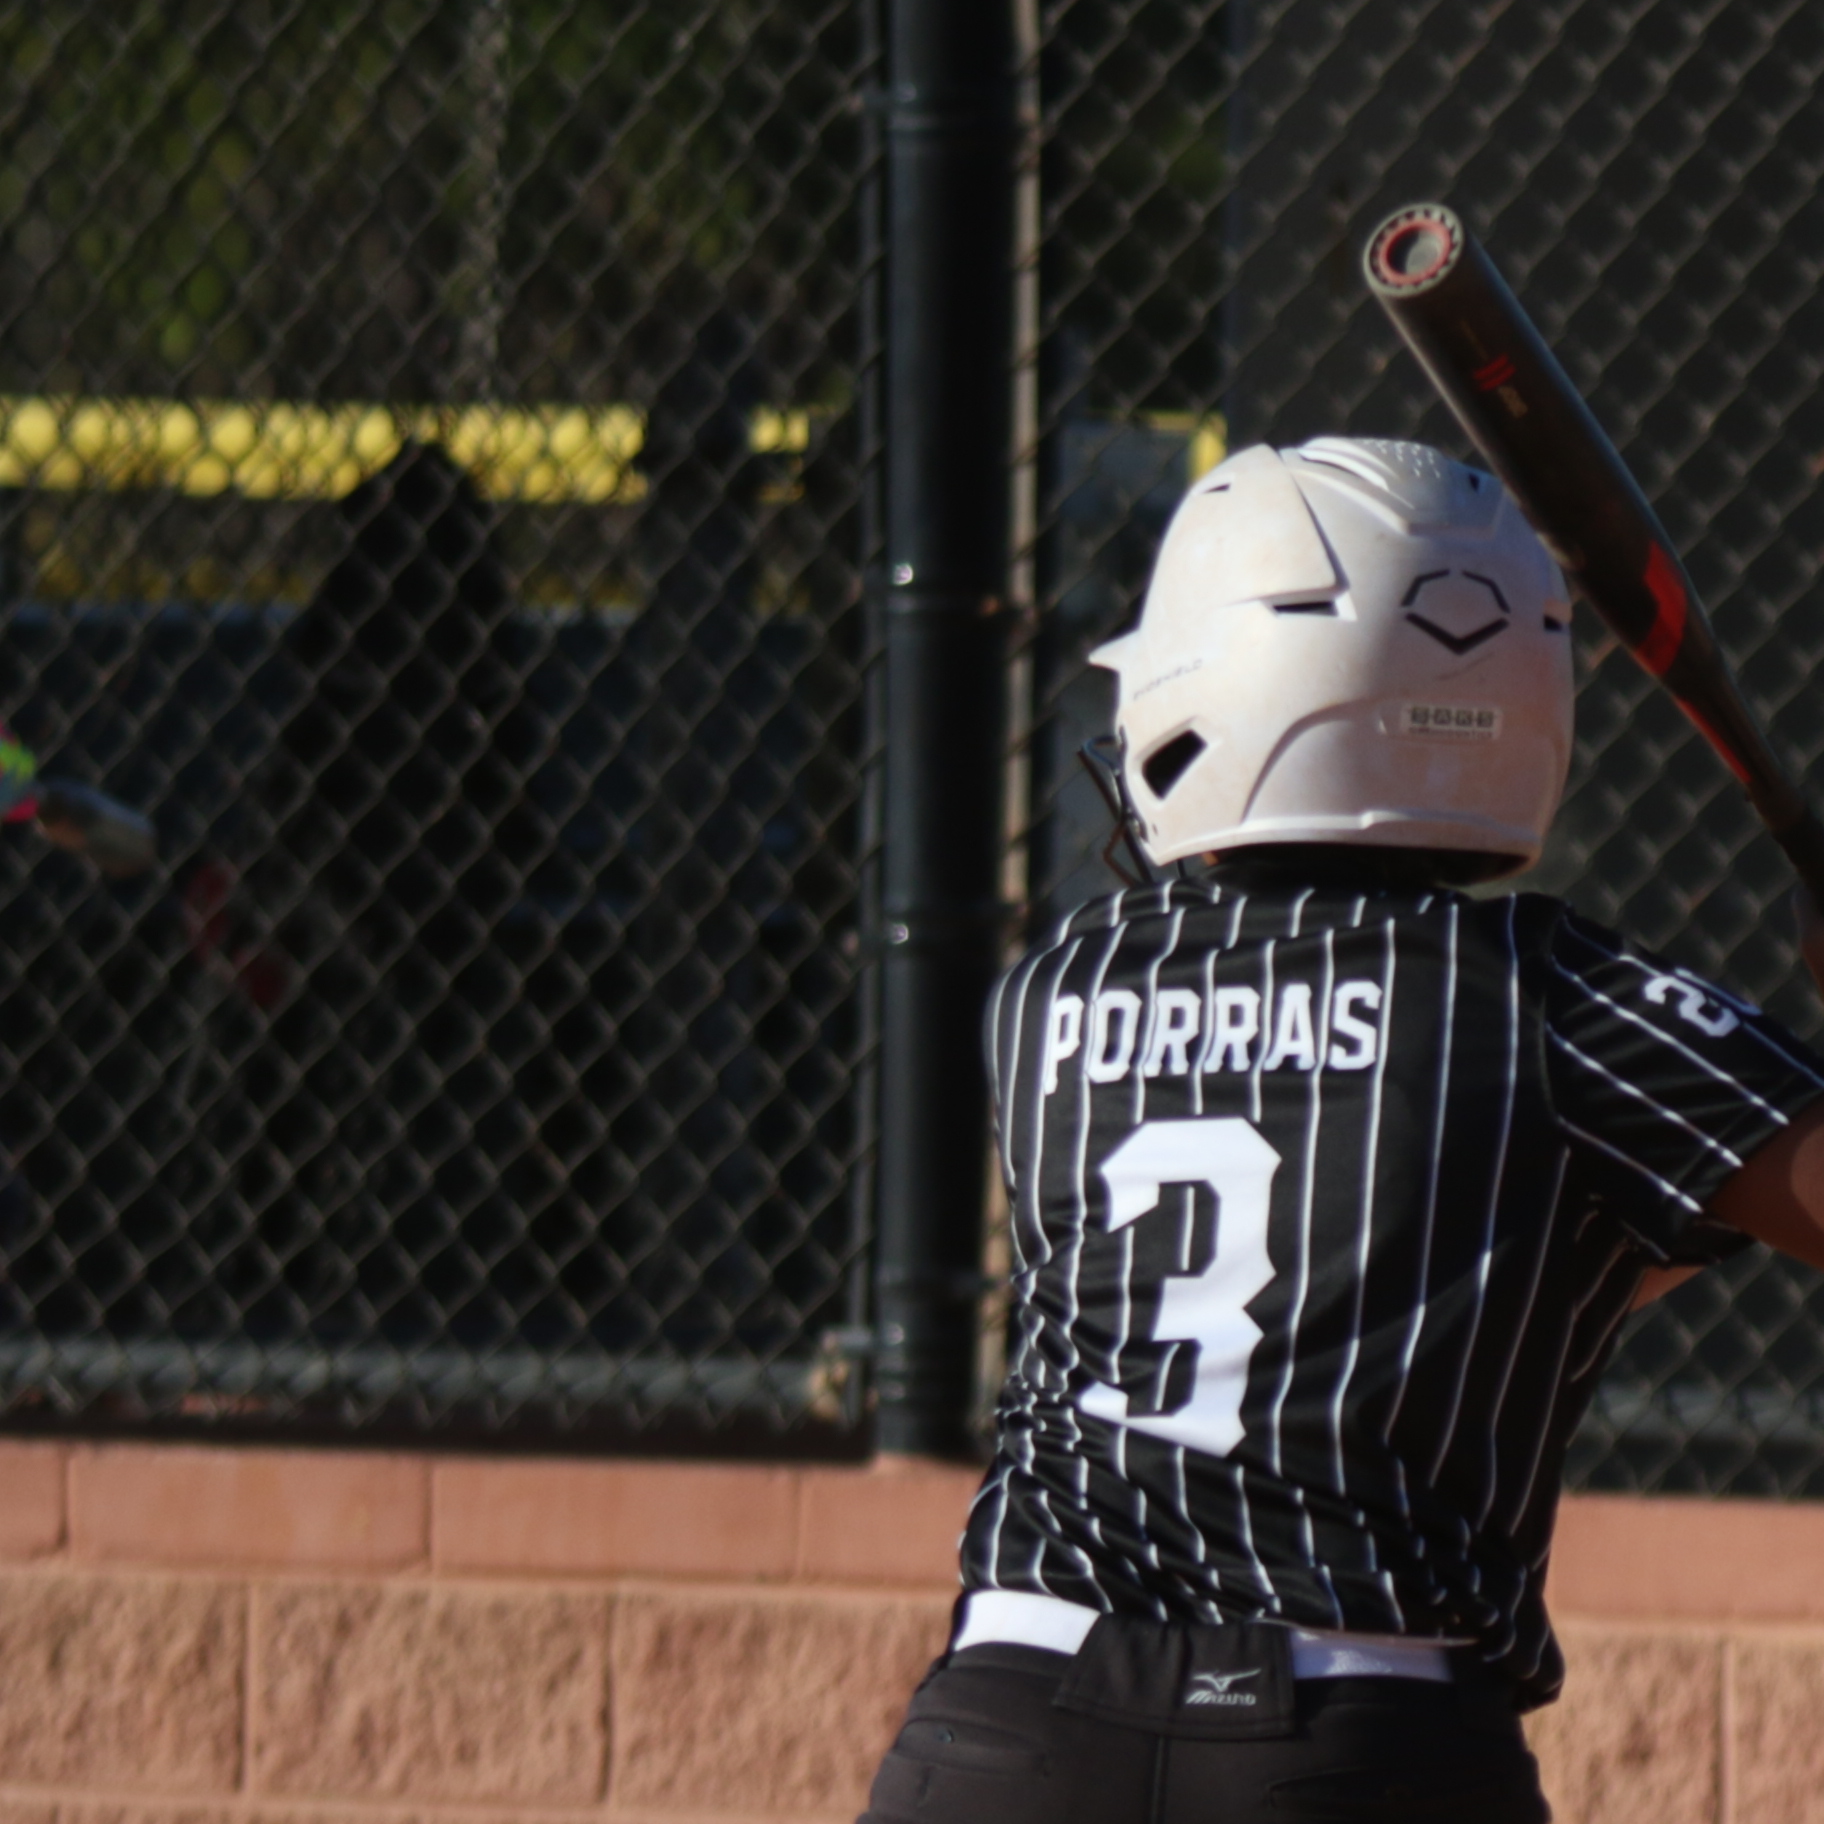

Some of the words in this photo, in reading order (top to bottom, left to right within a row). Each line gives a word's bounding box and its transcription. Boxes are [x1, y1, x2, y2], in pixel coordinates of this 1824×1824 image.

[1044, 980, 1384, 1096] PORRAS
[1643, 966, 1762, 1038] 2
[1079, 1116, 1283, 1459] 3
